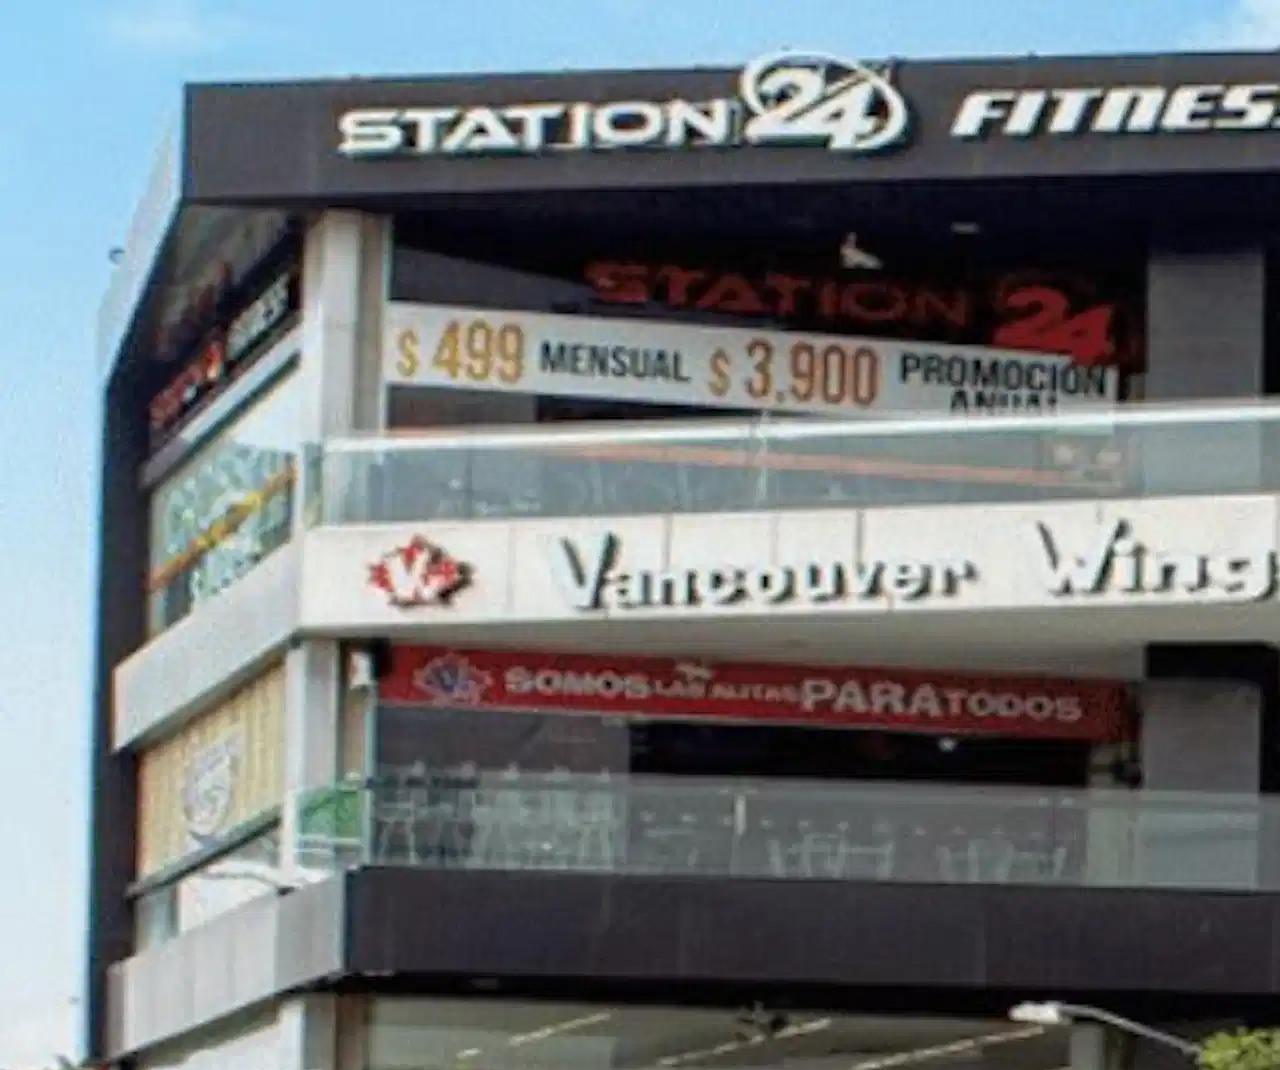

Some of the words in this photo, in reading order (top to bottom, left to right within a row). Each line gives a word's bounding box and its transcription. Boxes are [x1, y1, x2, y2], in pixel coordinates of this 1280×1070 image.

[338, 101, 736, 154] STATION
[746, 62, 886, 150] 24
[583, 261, 968, 328] STATION
[992, 286, 1116, 364] 24
[540, 340, 692, 384] MENSUAL
[556, 532, 976, 612] Vancouver
[503, 665, 650, 700] SOMOS
